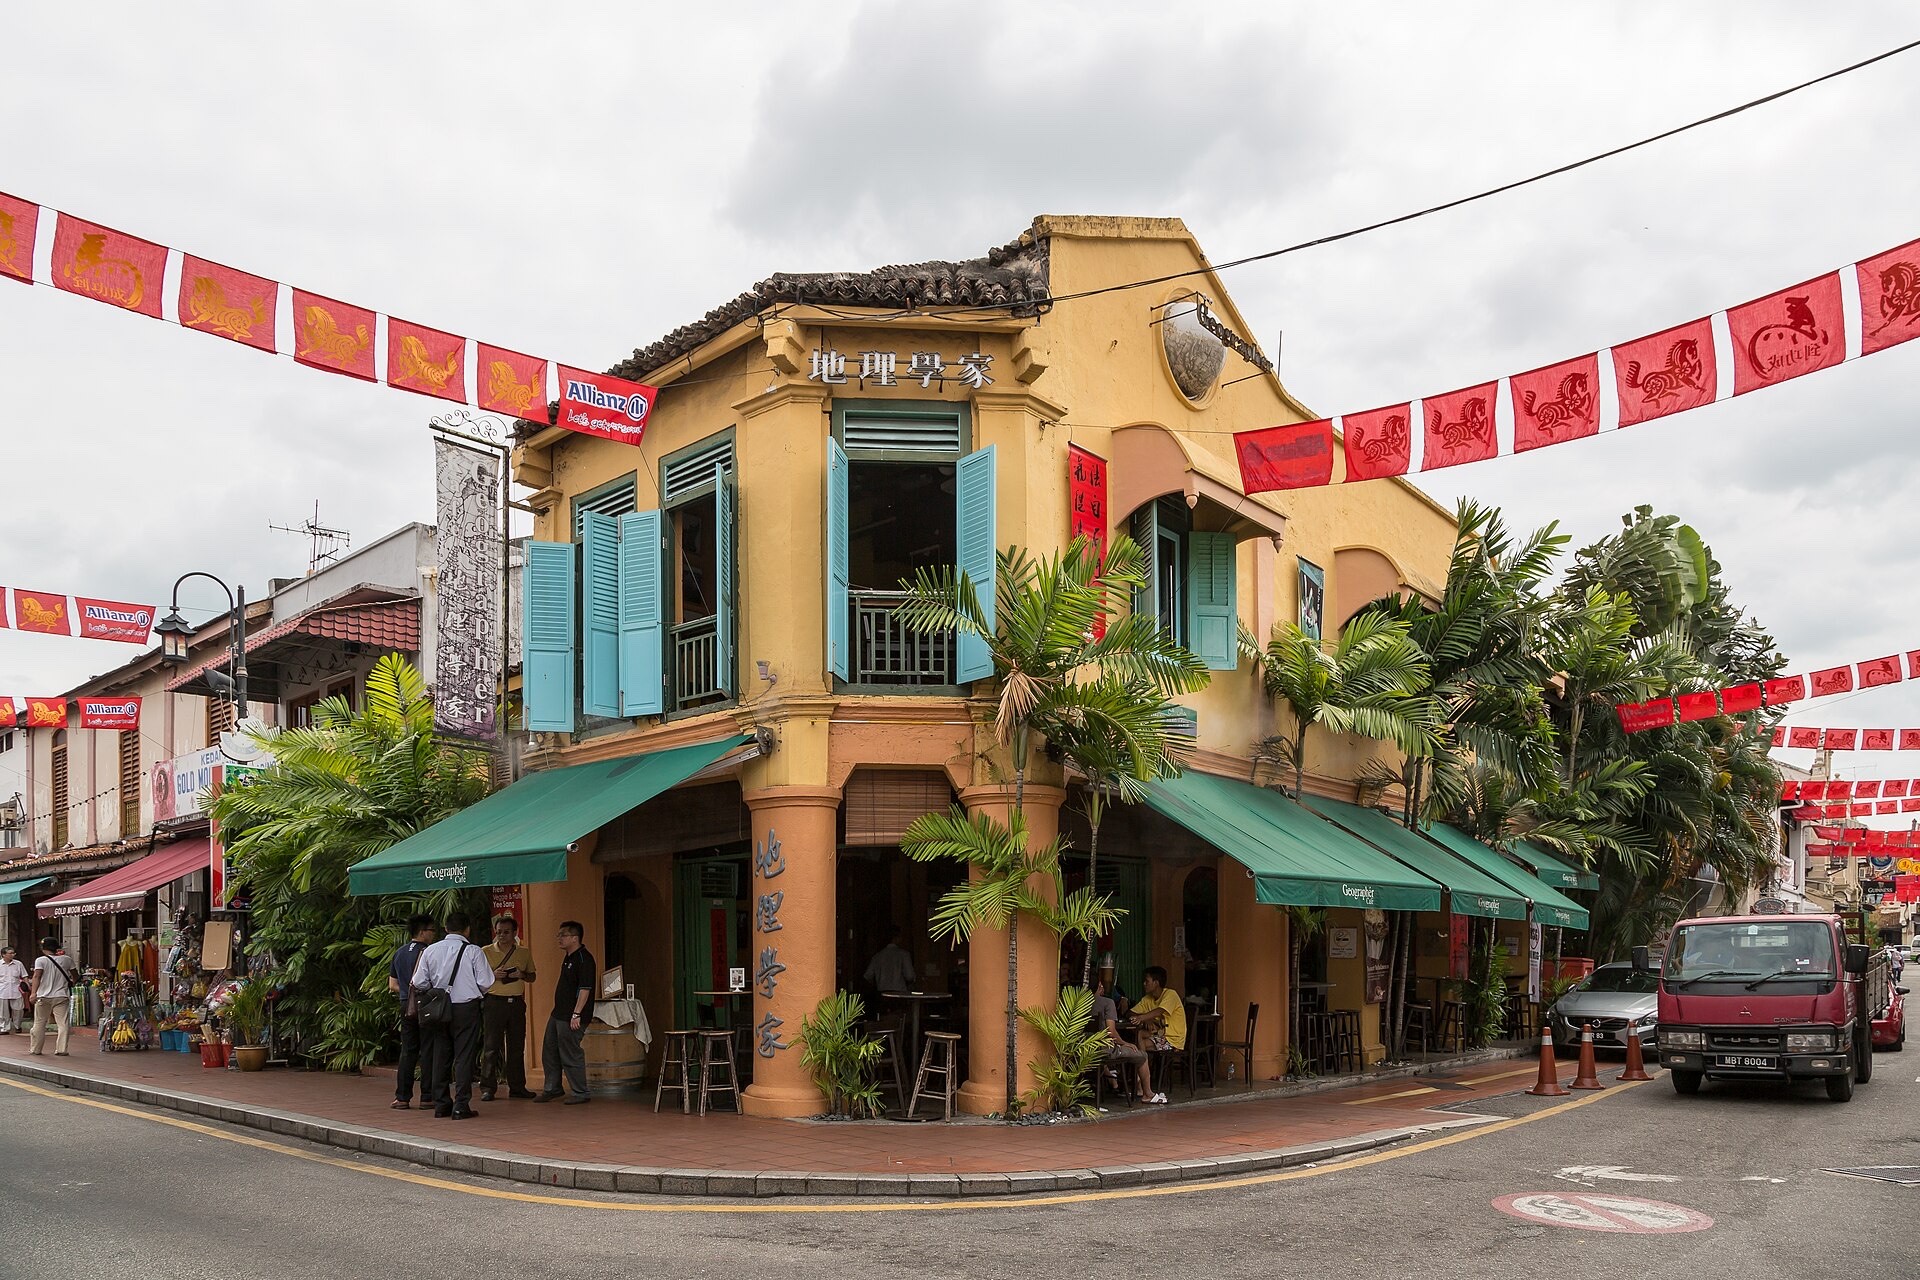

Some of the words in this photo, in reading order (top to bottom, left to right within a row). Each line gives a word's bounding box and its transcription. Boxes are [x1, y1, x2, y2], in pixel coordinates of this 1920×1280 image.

[807, 348, 996, 389] 地理學家
[566, 380, 627, 413] Allianz
[86, 605, 135, 622] Allianz
[86, 703, 124, 714] Allianz
[177, 771, 194, 795] GOLD
[54, 907, 66, 915] GOLD
[67, 905, 81, 914] MOON
[82, 904, 96, 912] COINS
[503, 900, 515, 908] Sang
[1725, 1056, 1744, 1065] MBT
[1745, 1057, 1767, 1066] 8004
